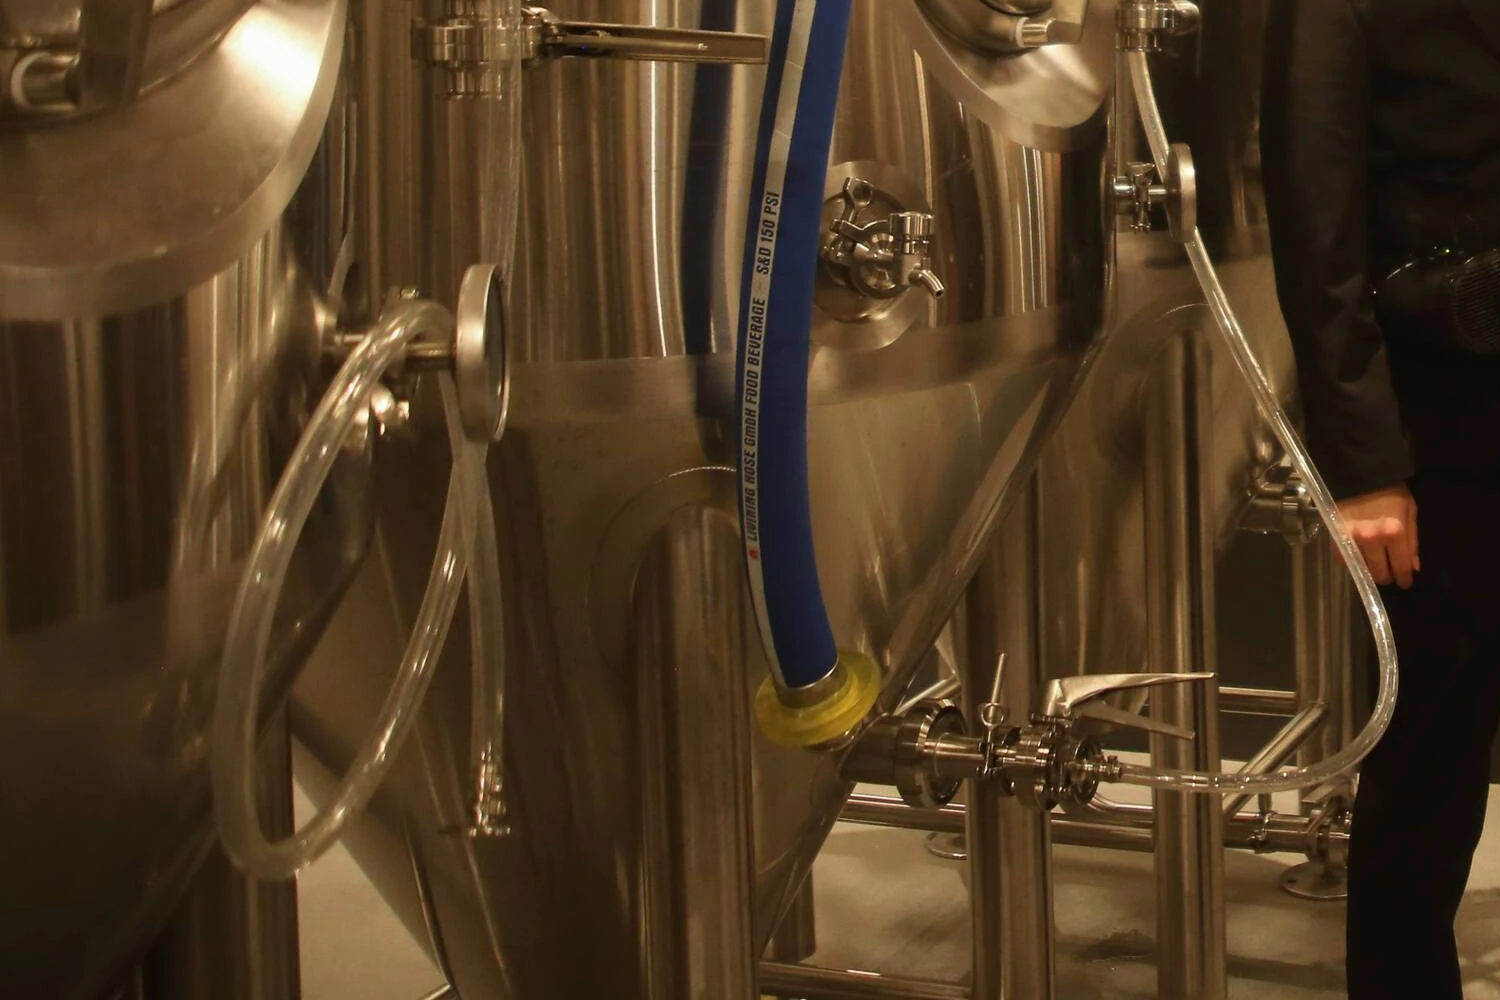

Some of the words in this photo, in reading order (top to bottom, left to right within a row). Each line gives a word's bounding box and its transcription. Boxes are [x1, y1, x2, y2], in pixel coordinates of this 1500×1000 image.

[764, 191, 780, 215] PSI
[760, 219, 775, 242] 150
[756, 246, 771, 275] S&D
[748, 297, 766, 367] BEVERAGE
[745, 370, 759, 404] FOOD
[743, 449, 756, 485] HOSE
